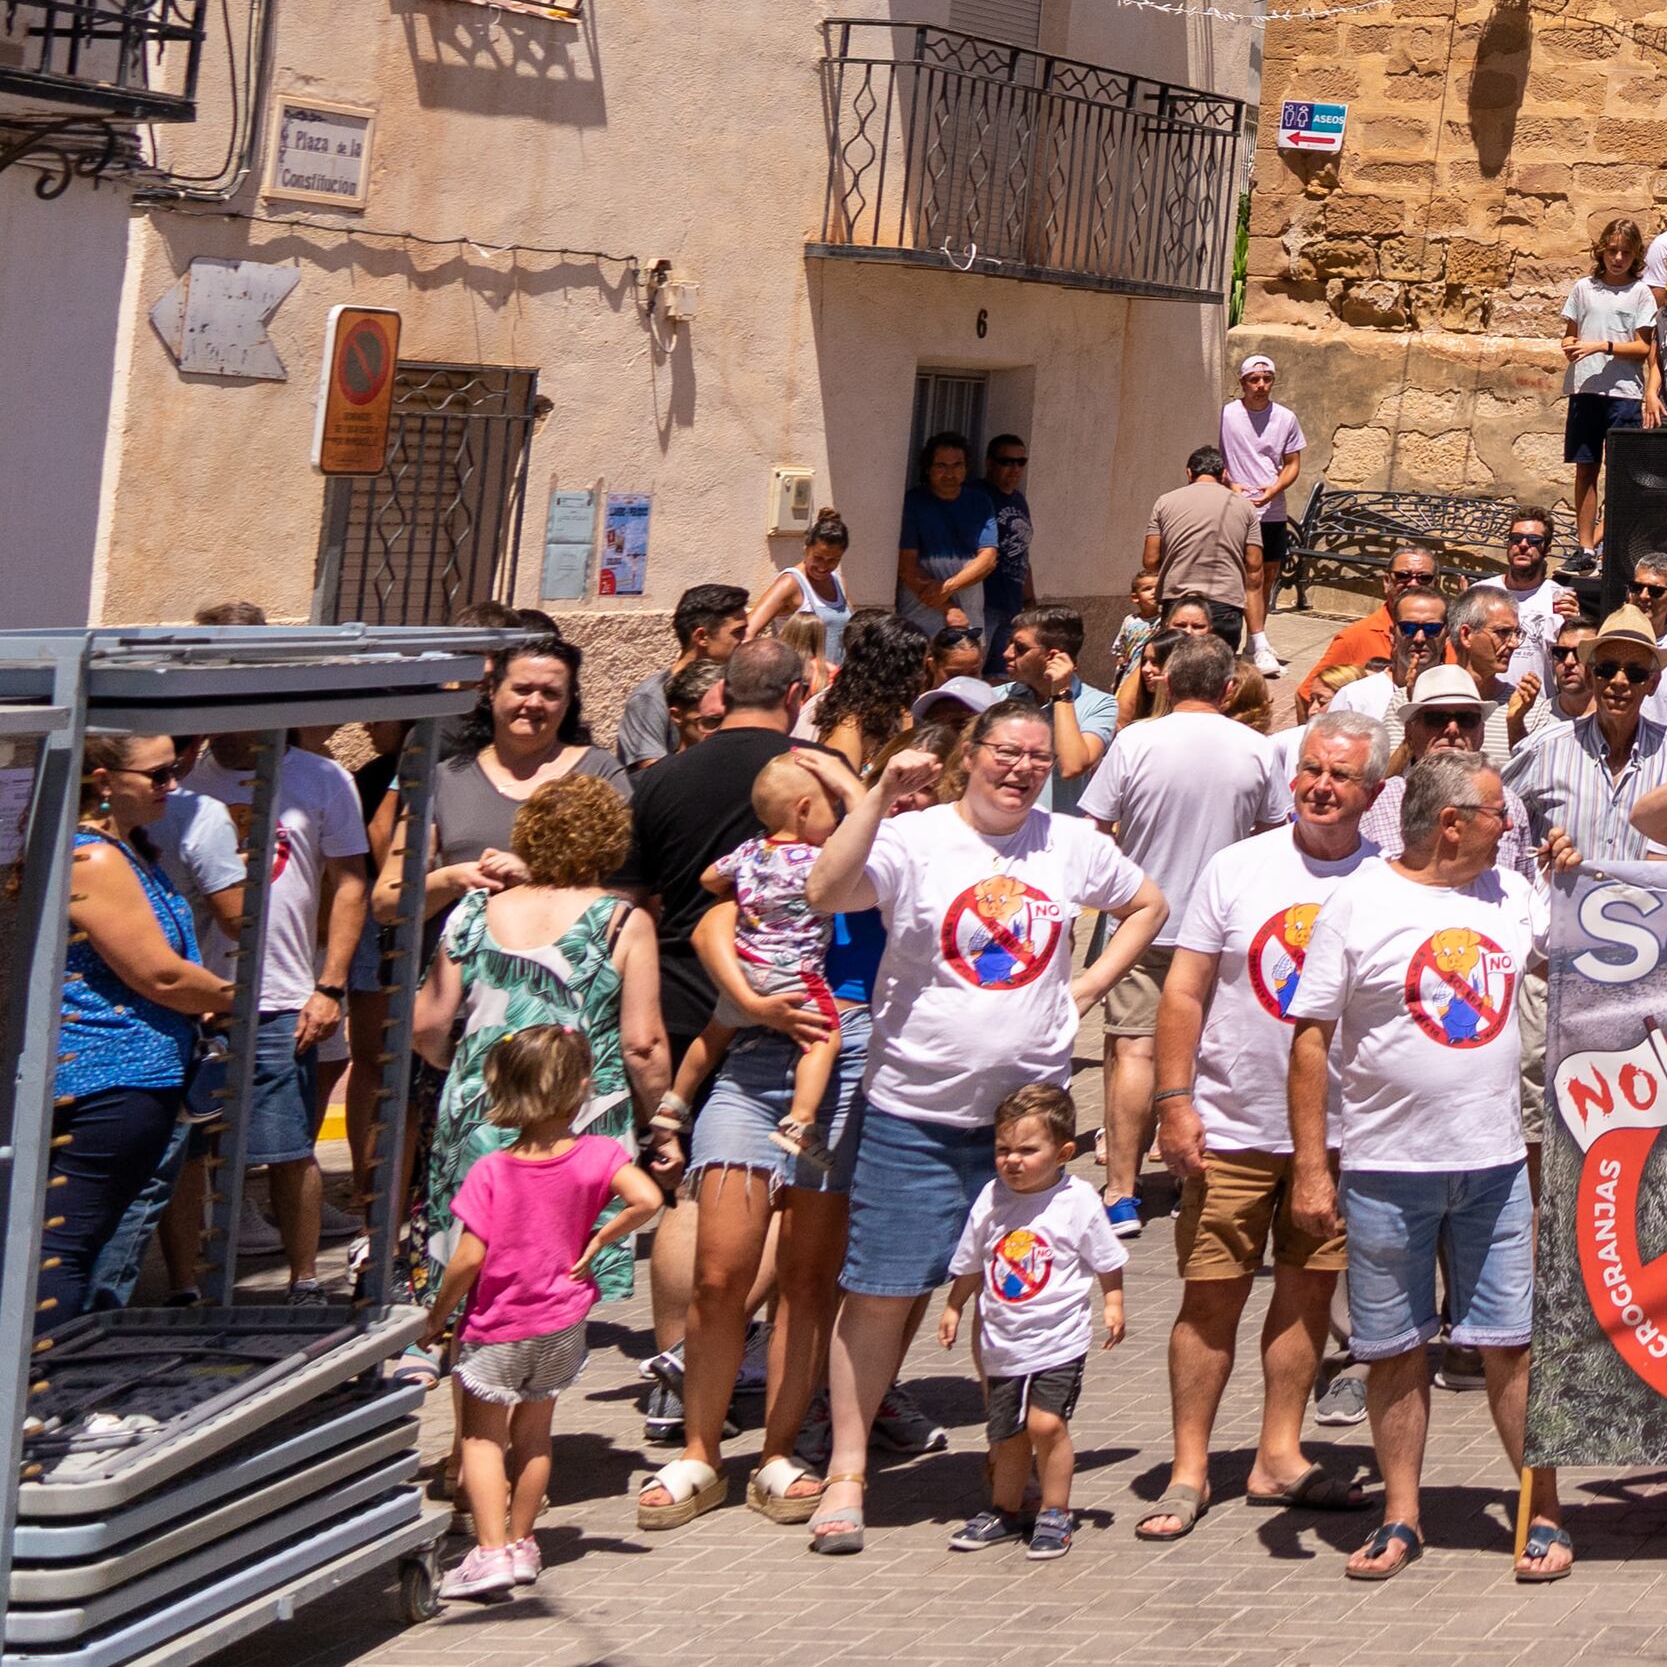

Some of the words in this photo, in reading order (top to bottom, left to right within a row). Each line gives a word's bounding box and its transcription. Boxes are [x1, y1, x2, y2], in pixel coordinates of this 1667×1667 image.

[1313, 114, 1344, 134] ASEOS
[296, 130, 329, 153] Plaza
[350, 138, 363, 158] la
[976, 307, 989, 340] 6
[1035, 904, 1061, 917] NO
[1489, 955, 1512, 971] NO
[1566, 1061, 1659, 1127] NO
